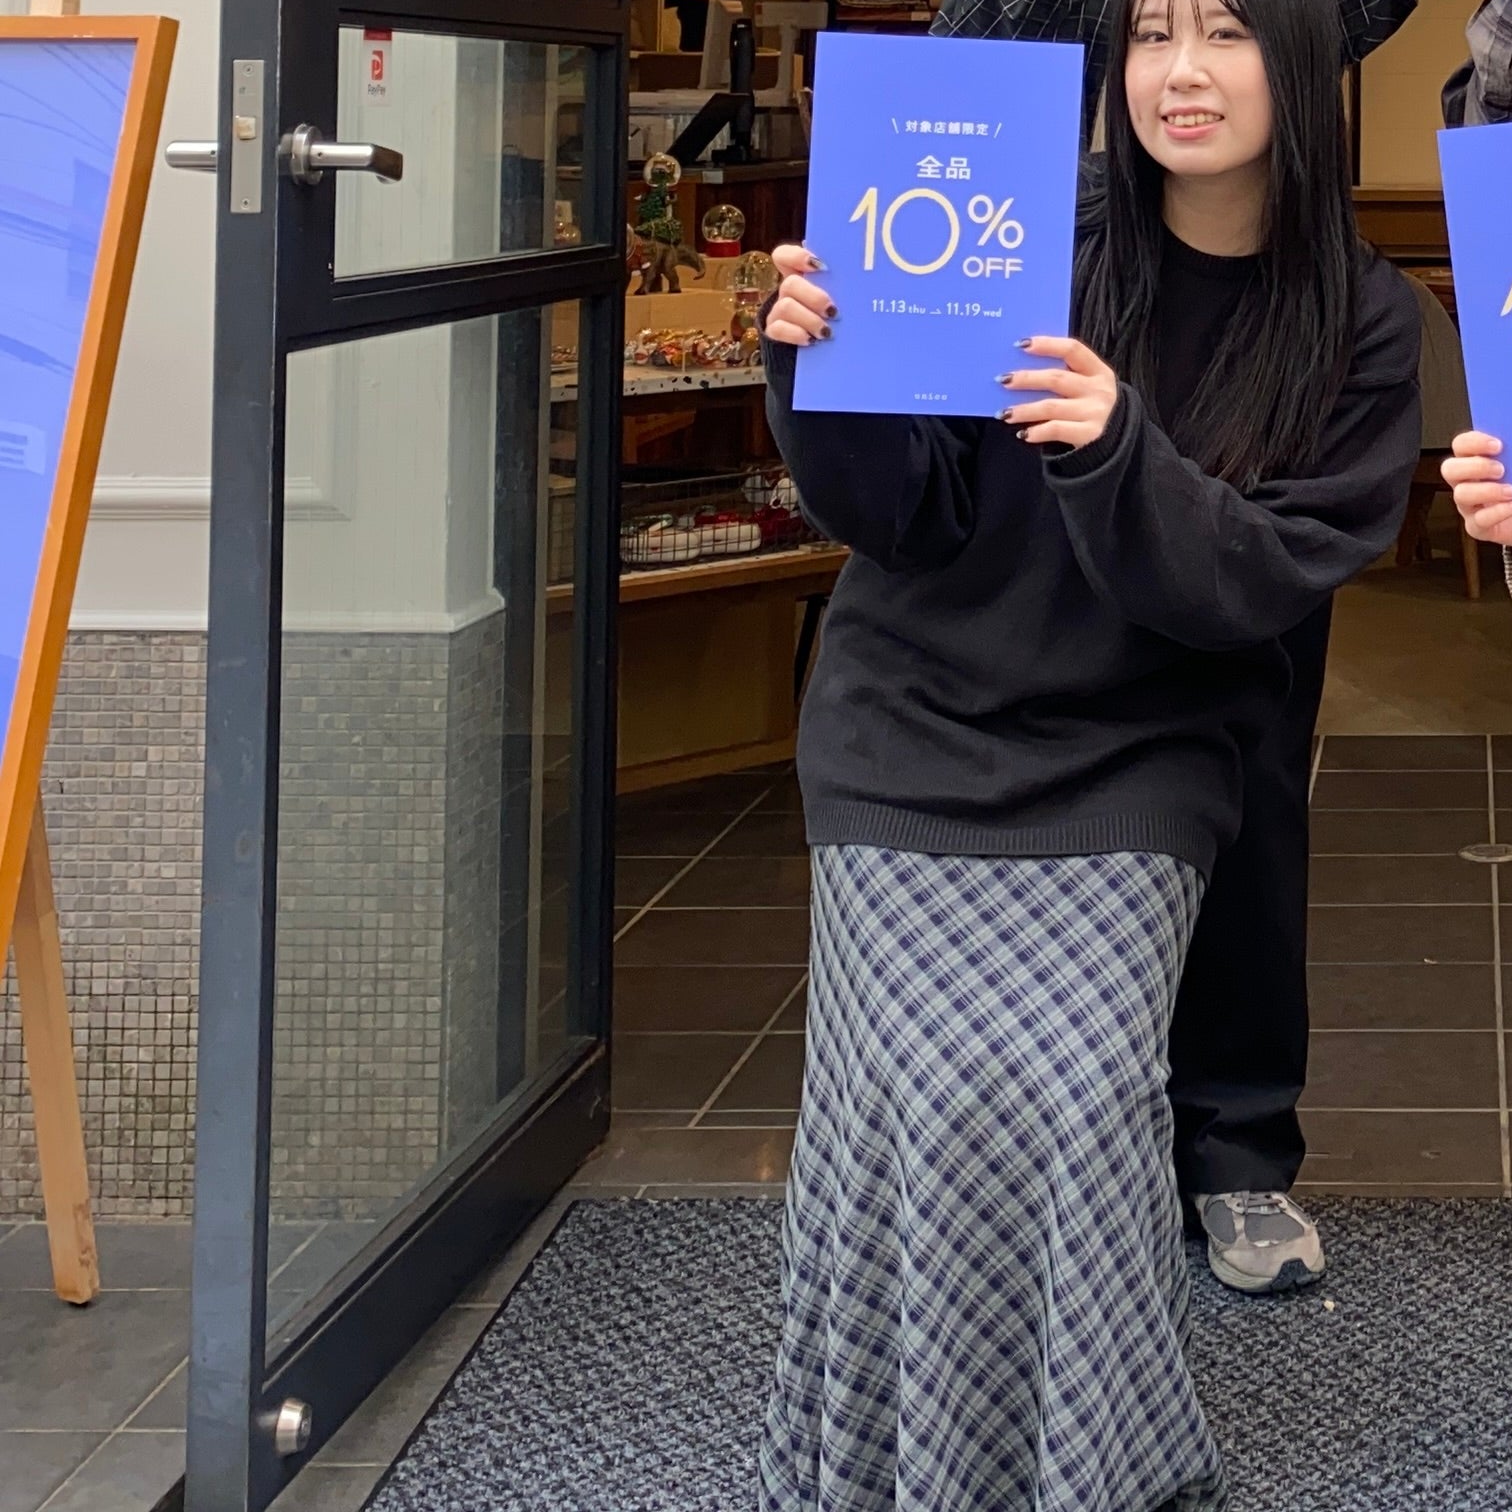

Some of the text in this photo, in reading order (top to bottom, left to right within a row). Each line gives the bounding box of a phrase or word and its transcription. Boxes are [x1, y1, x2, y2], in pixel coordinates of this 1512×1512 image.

[905, 119, 989, 137] 対象店舗限定
[916, 155, 971, 180] 全品
[962, 256, 1024, 279] OFF
[872, 298, 1002, 318] 11.13 thu 11.19 wed
